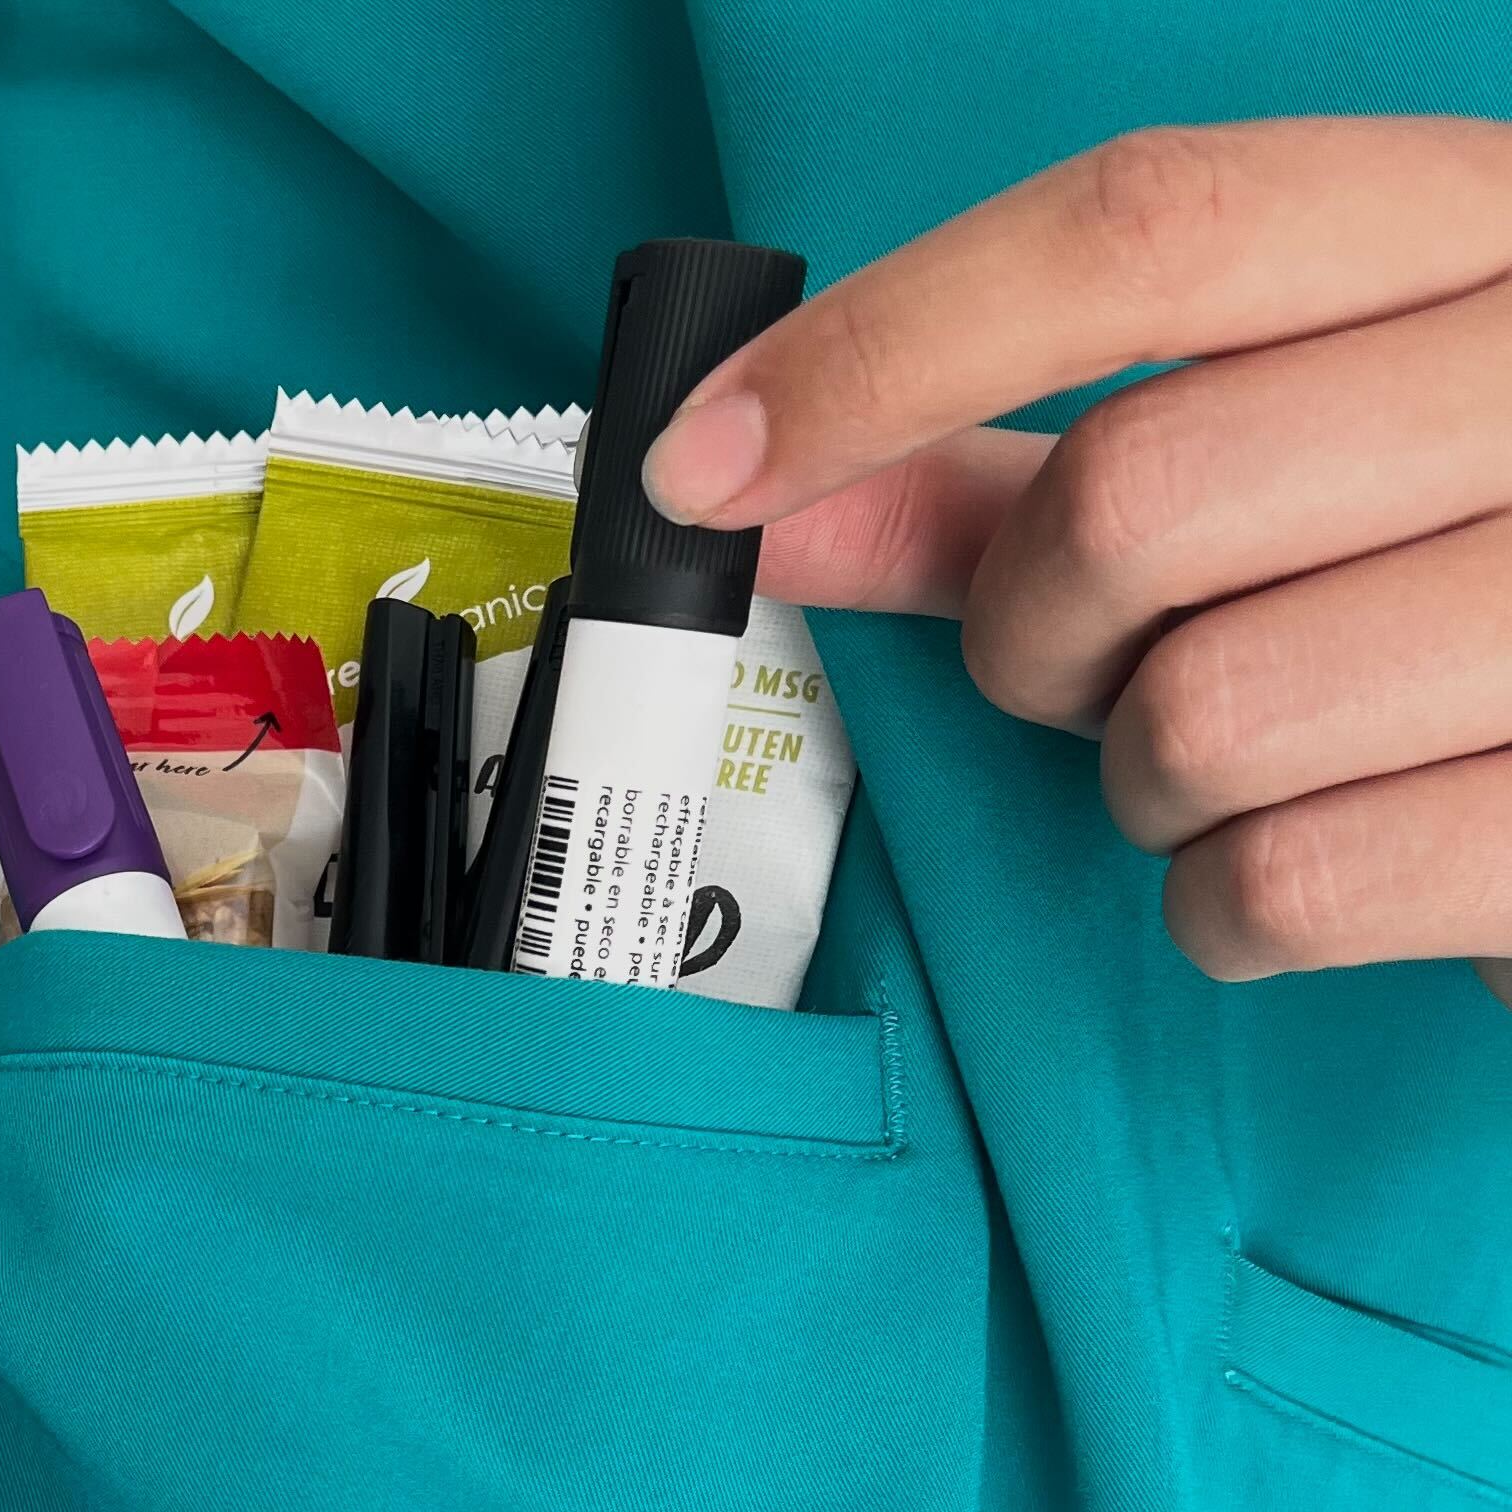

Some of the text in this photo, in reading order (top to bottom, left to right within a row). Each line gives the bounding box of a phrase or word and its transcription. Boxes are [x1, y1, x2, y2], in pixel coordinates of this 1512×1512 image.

[459, 584, 546, 632] anic
[753, 664, 824, 703] MSG
[722, 723, 805, 763] UTEN
[155, 759, 211, 776] here
[715, 758, 773, 795] REE
[583, 785, 614, 896] recargable
[611, 789, 642, 877] borrable
[638, 792, 671, 929] rechargeable
[606, 884, 622, 909] en
[597, 916, 616, 960] seco
[655, 916, 669, 945] sec
[649, 952, 663, 983] sur
